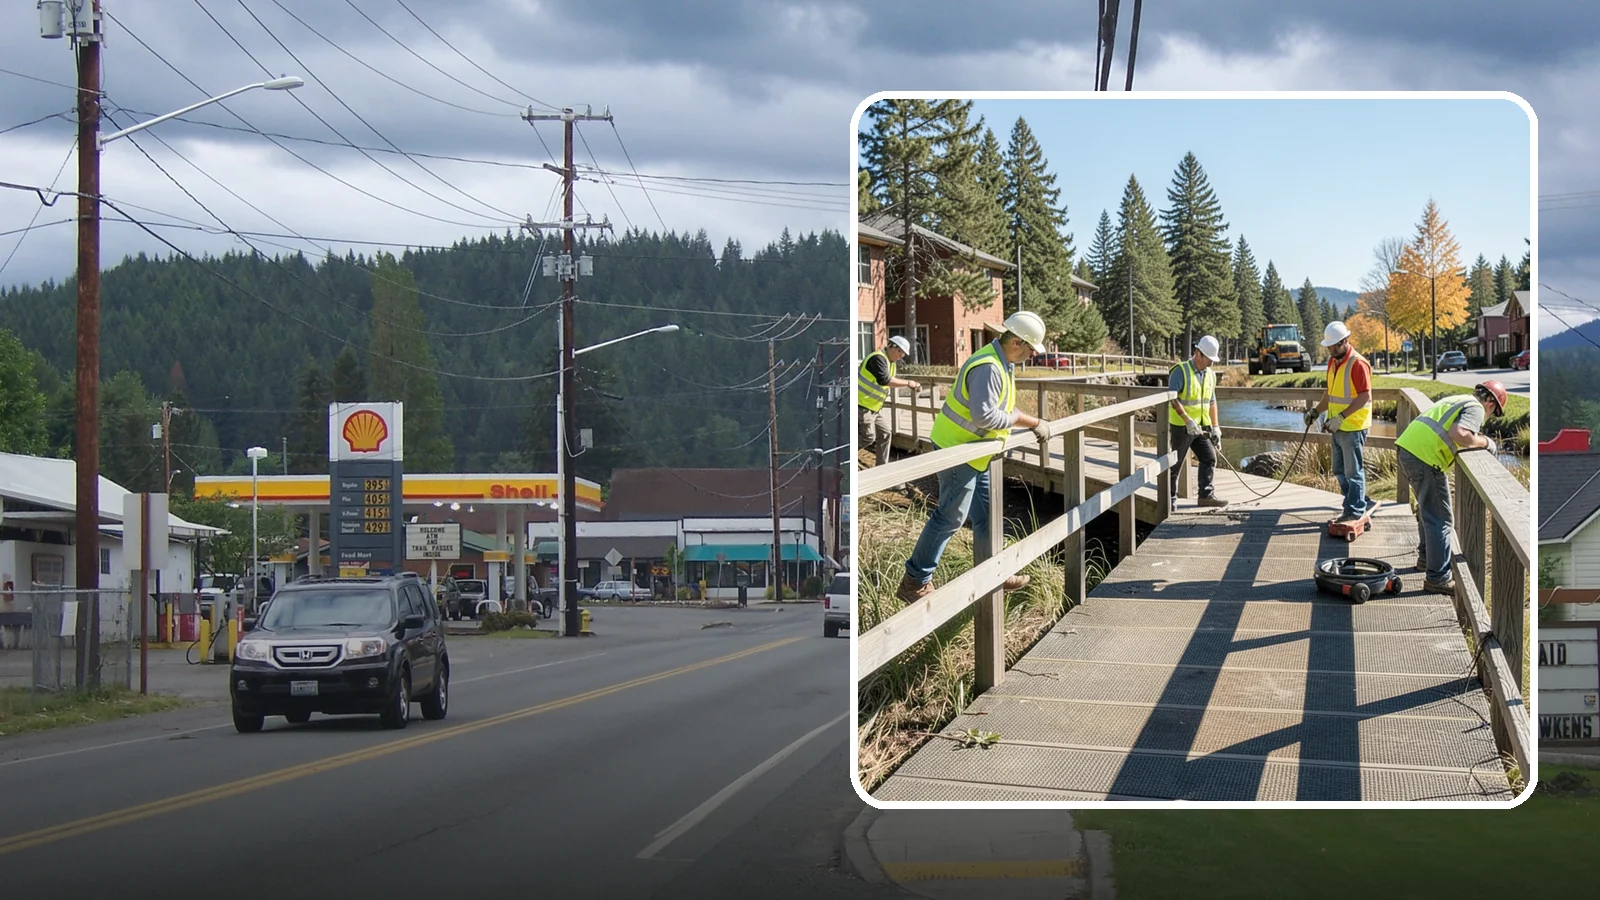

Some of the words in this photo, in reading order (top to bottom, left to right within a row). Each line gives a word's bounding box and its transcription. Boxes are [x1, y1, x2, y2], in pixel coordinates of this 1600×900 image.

[366, 480, 384, 490] 395
[490, 484, 547, 499] Shell
[365, 494, 384, 504] 405
[365, 508, 384, 518] 415
[365, 522, 384, 533] 429
[1539, 643, 1566, 665] AID
